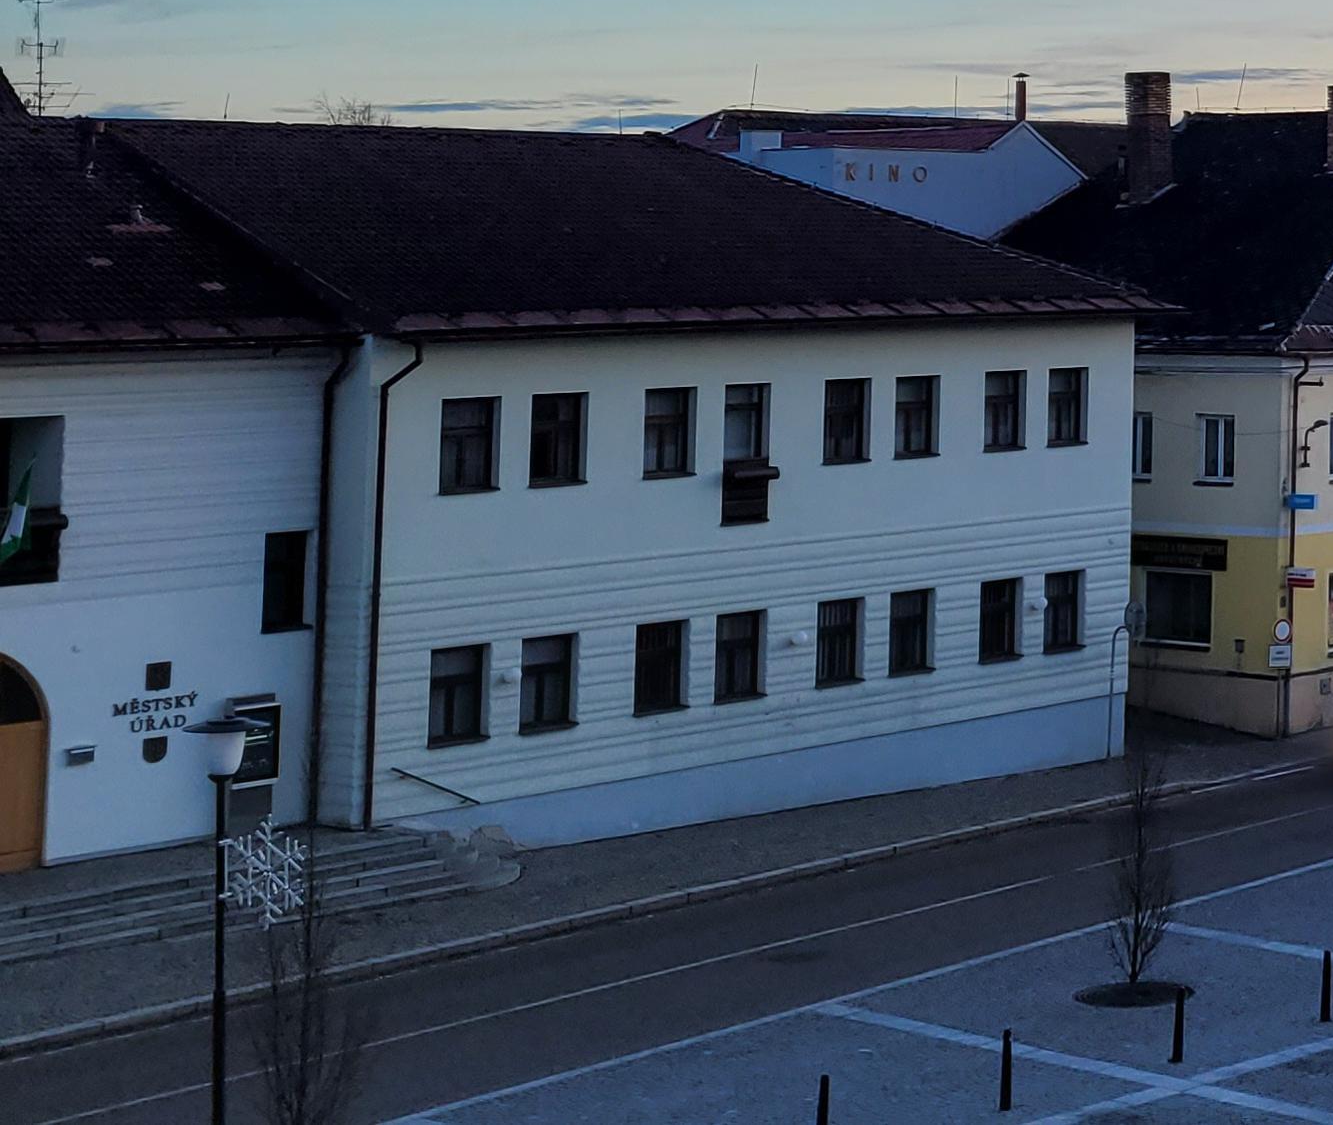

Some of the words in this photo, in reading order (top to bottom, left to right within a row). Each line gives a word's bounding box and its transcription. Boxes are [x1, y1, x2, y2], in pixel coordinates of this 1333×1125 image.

[846, 162, 927, 183] KINO
[112, 690, 198, 717] MĚSTSKÝ
[130, 715, 187, 732] ÚŘAD
